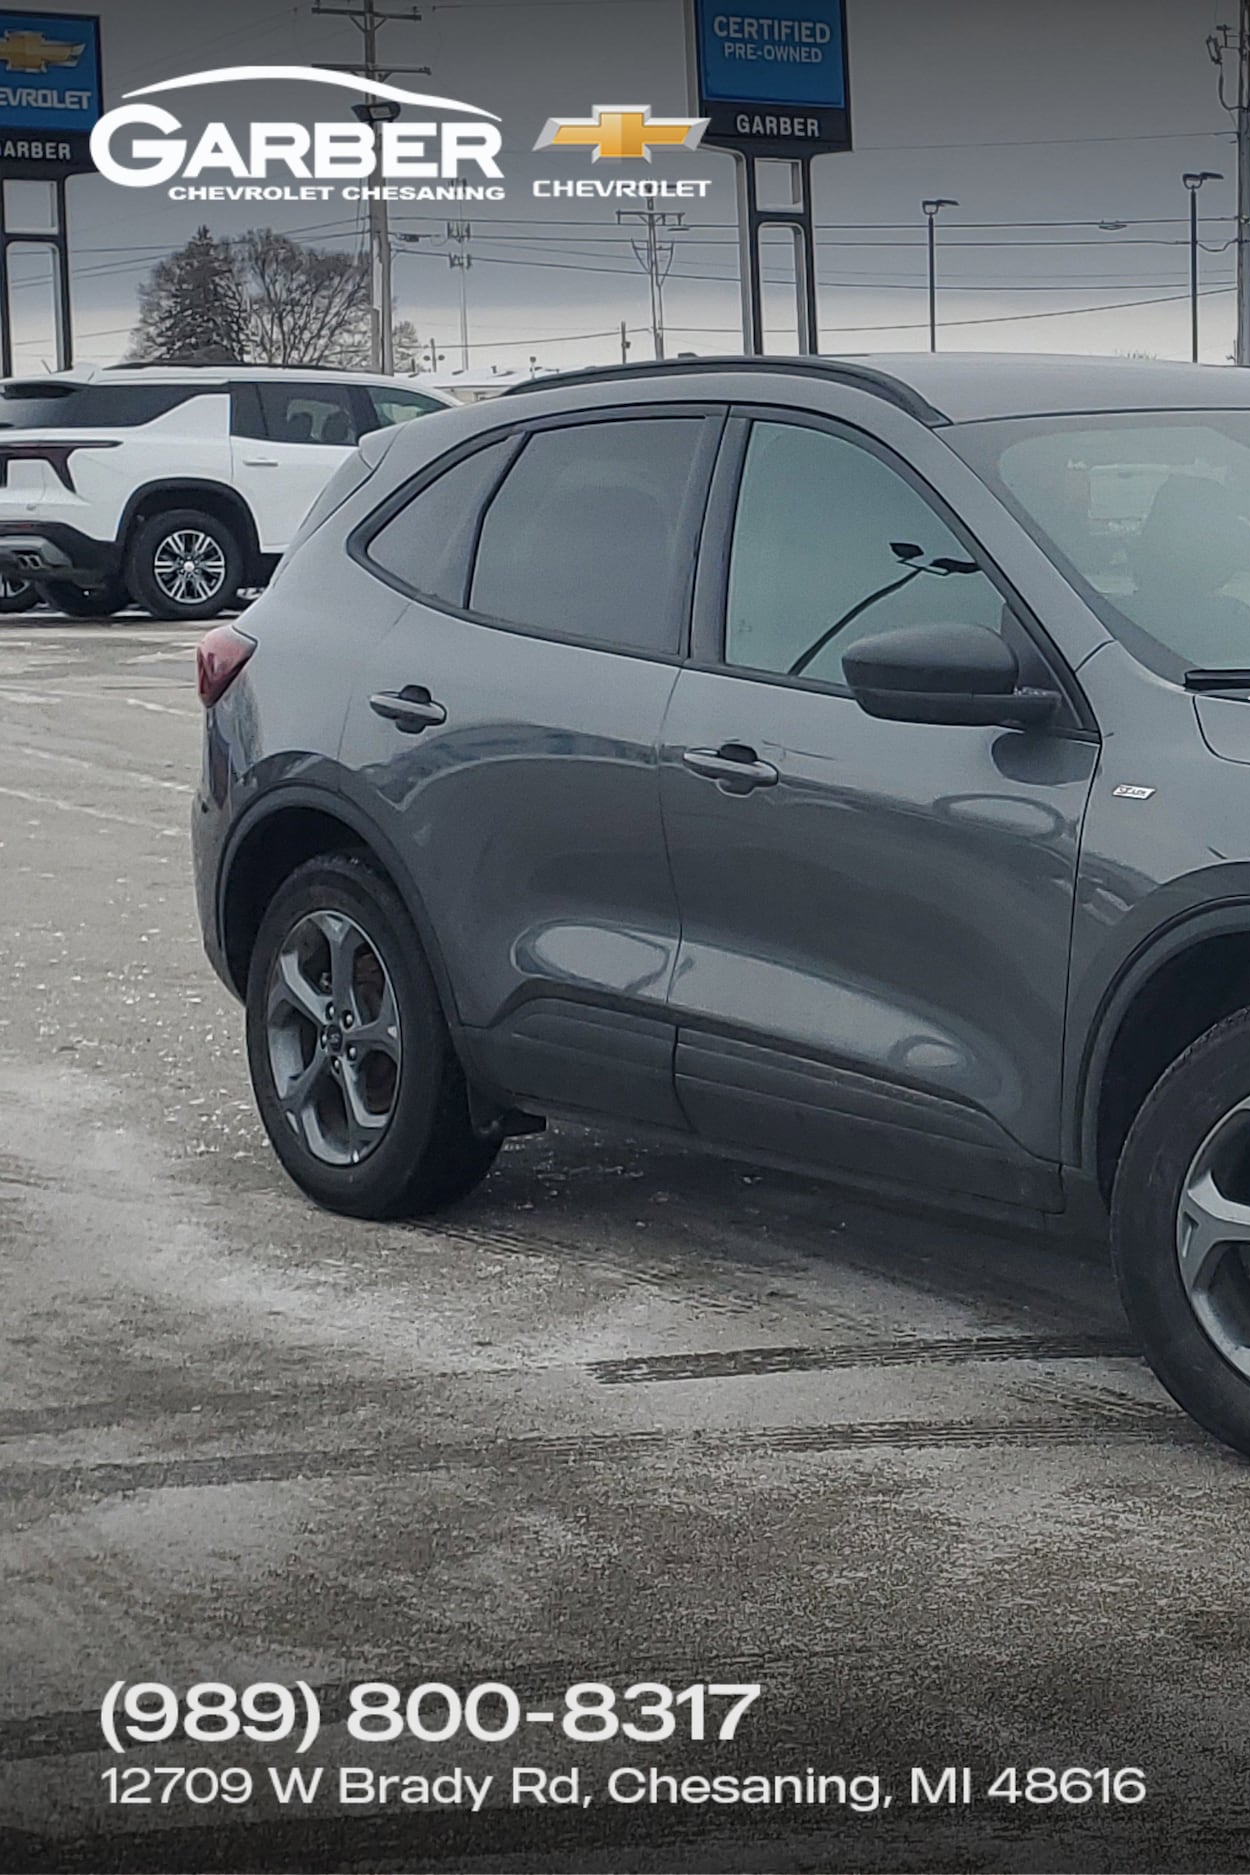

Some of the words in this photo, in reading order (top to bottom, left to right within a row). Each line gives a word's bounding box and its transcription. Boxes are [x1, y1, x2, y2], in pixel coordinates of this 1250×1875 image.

[713, 15, 831, 44] CERTIFIED
[724, 42, 822, 63] PRE-OWNED
[736, 114, 820, 137] GARBER
[0, 140, 71, 160] ARBER
